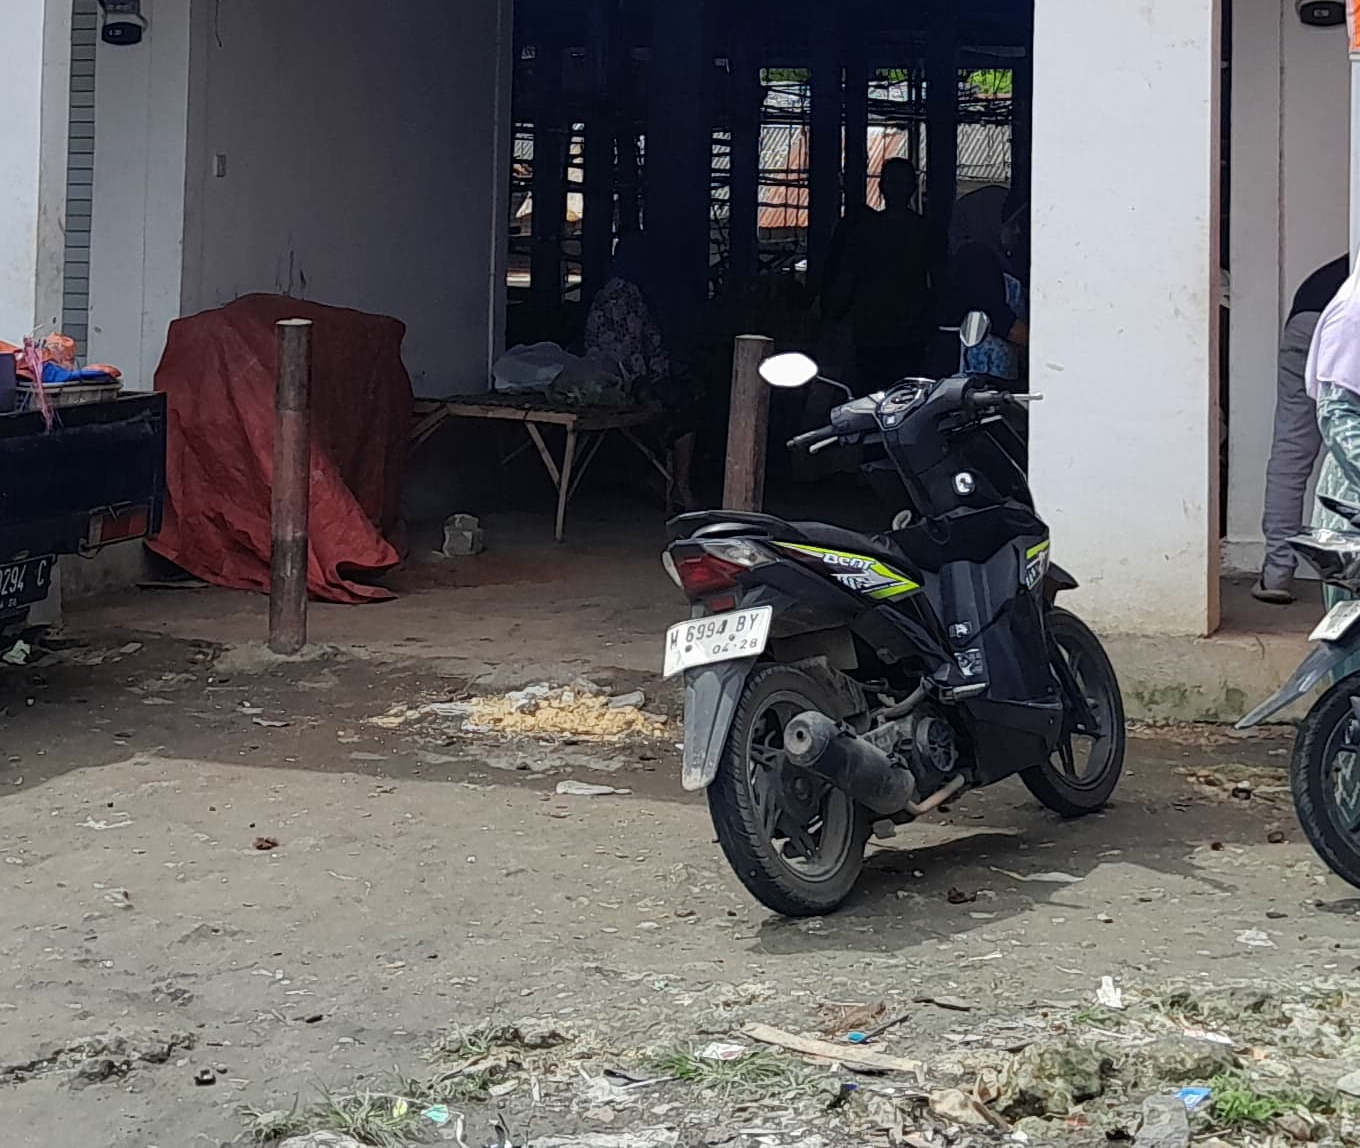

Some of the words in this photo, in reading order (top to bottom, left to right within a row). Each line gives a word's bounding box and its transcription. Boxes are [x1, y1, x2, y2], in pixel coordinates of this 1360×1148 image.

[36, 559, 47, 587] C
[685, 619, 729, 643] 6994
[735, 613, 759, 632] BY
